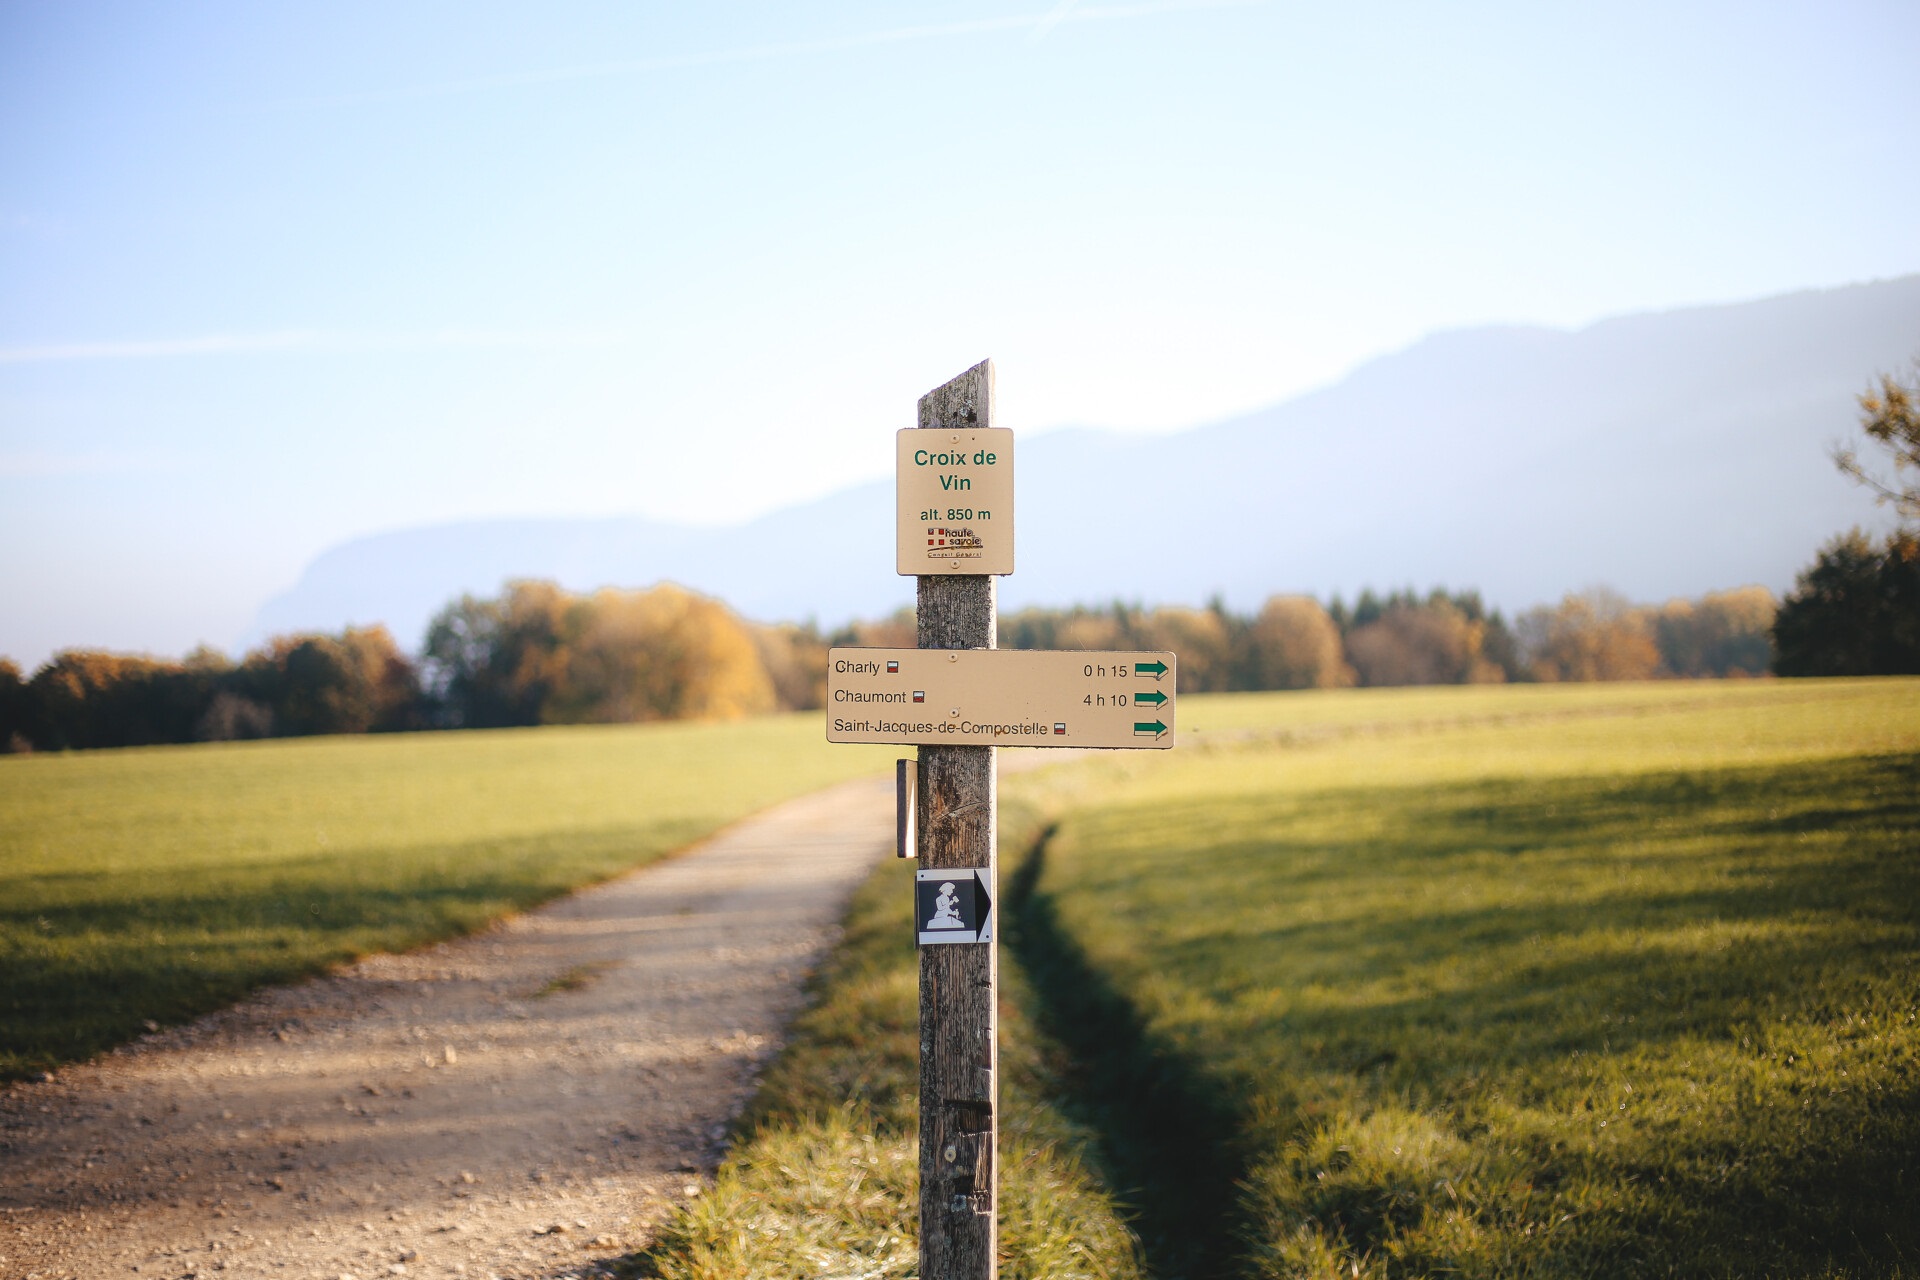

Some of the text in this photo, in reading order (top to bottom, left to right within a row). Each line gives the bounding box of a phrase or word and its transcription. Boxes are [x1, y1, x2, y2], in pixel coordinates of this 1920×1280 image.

[914, 449, 997, 466] Croix de
[939, 474, 971, 491] Vin
[920, 508, 991, 521] alt. 850 m
[945, 527, 974, 538] haute
[835, 660, 881, 676] Charly
[1084, 664, 1128, 677] 0 h 15
[834, 689, 907, 703] Chaumont
[1083, 694, 1127, 707] 4 h 10
[834, 718, 1048, 738] Saint-Jacques-de-Compostelle
